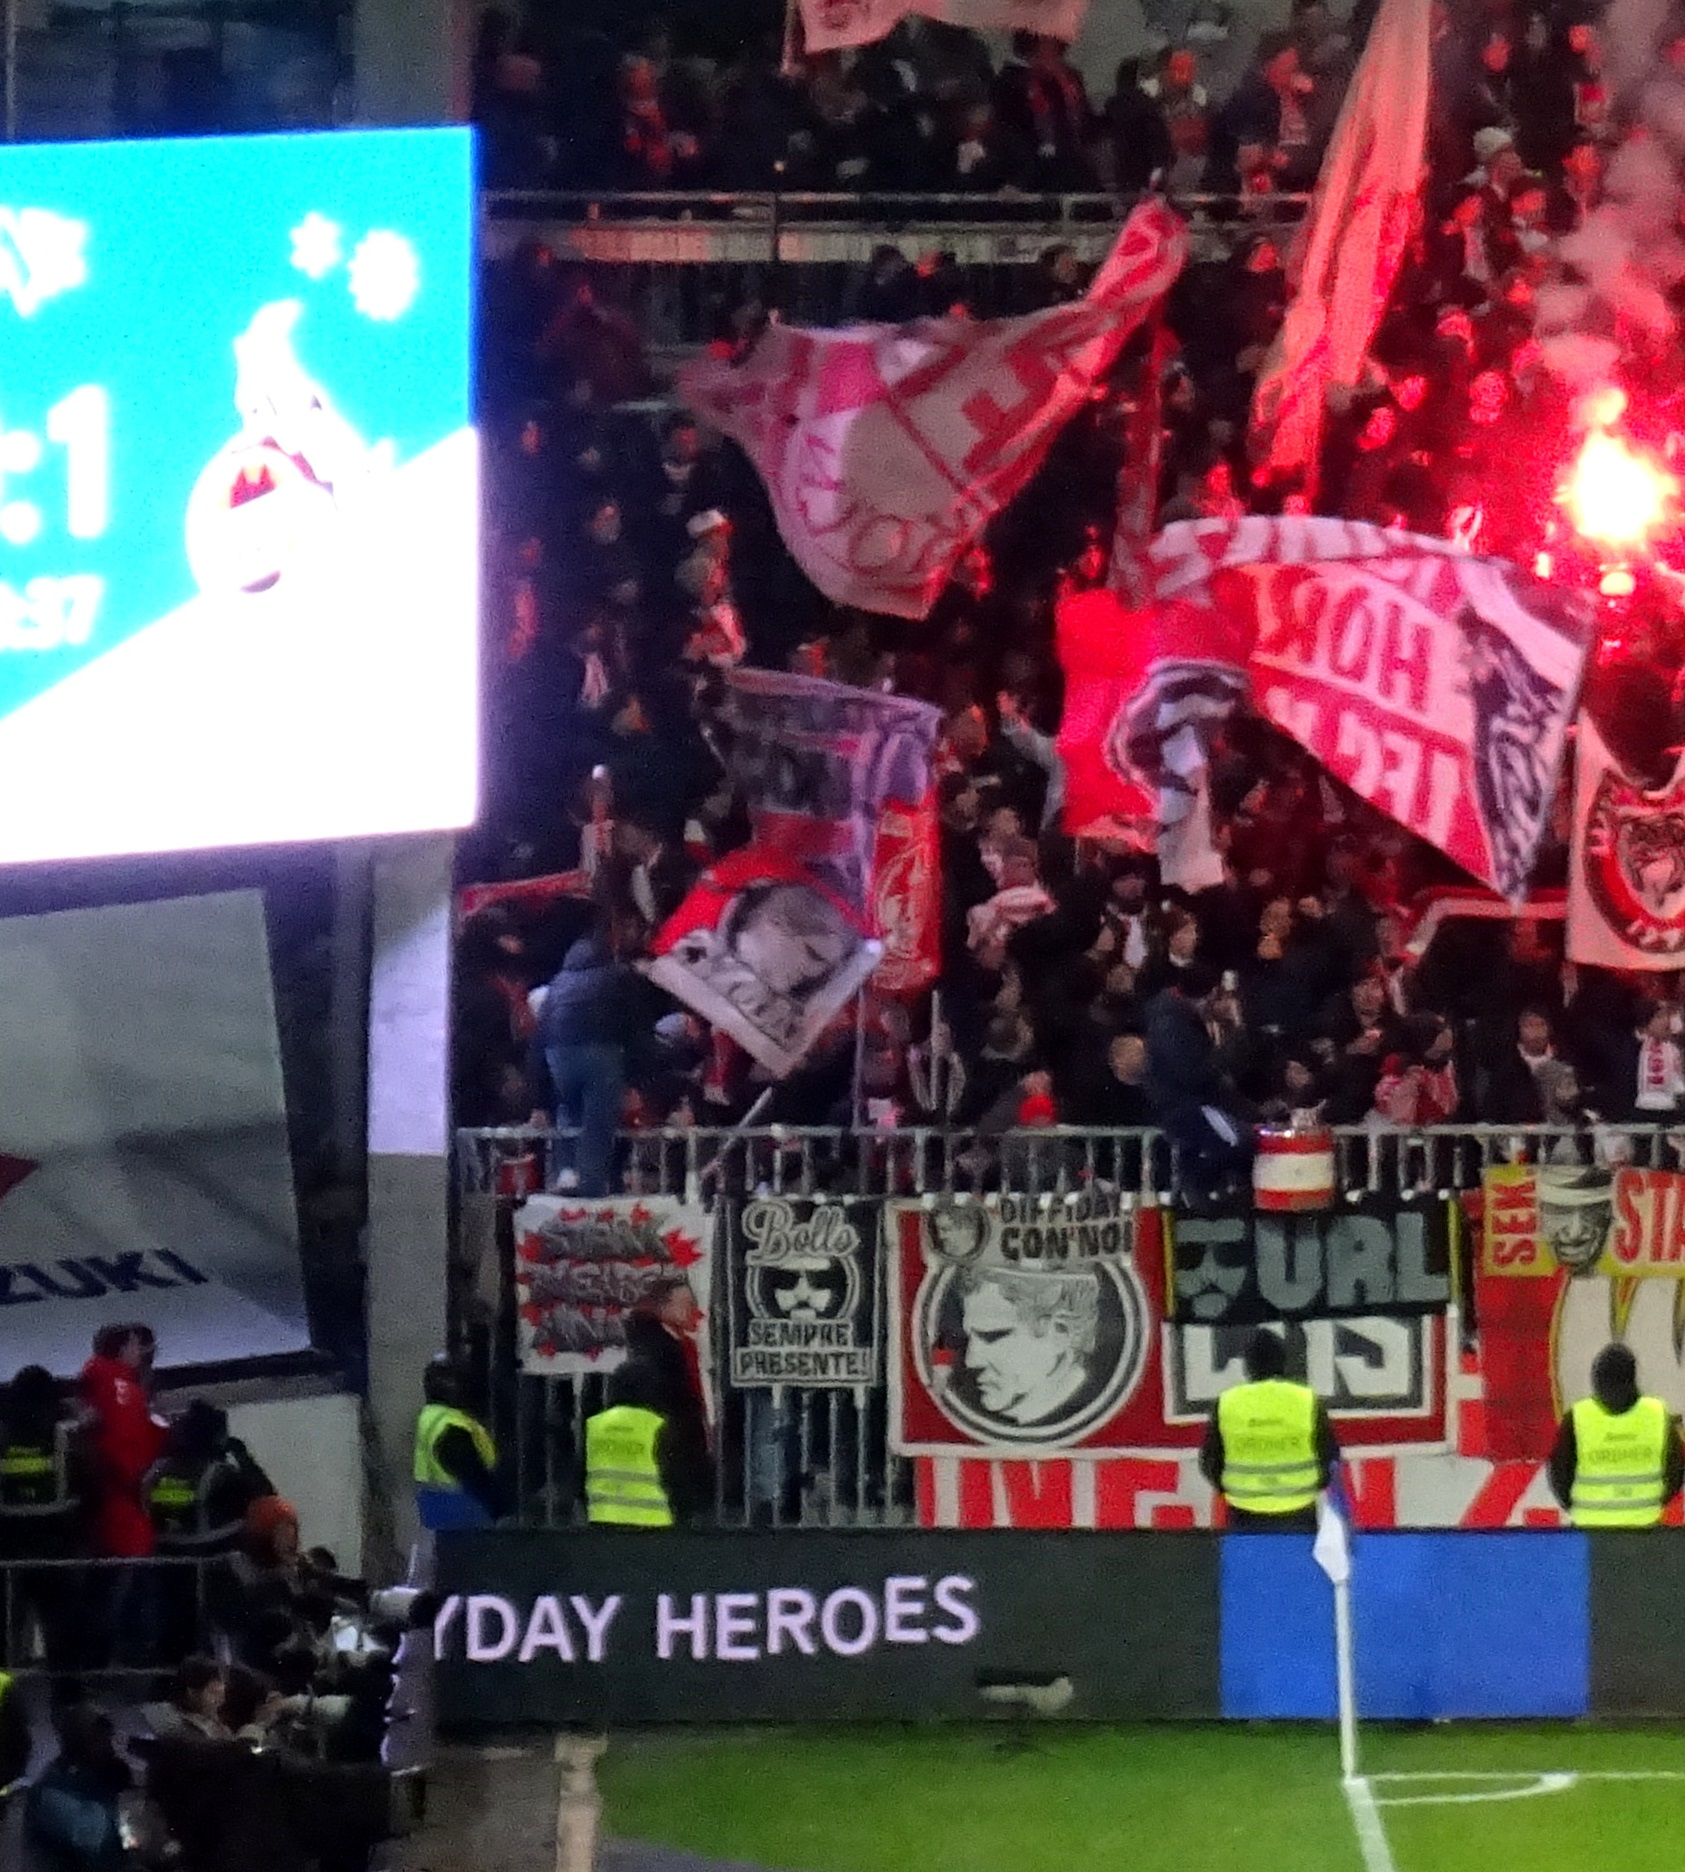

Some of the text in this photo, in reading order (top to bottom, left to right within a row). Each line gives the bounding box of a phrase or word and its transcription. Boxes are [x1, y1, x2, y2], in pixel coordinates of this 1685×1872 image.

[1001, 1220, 1134, 1261] CON NOI
[657, 1573, 981, 1662] HEROES
